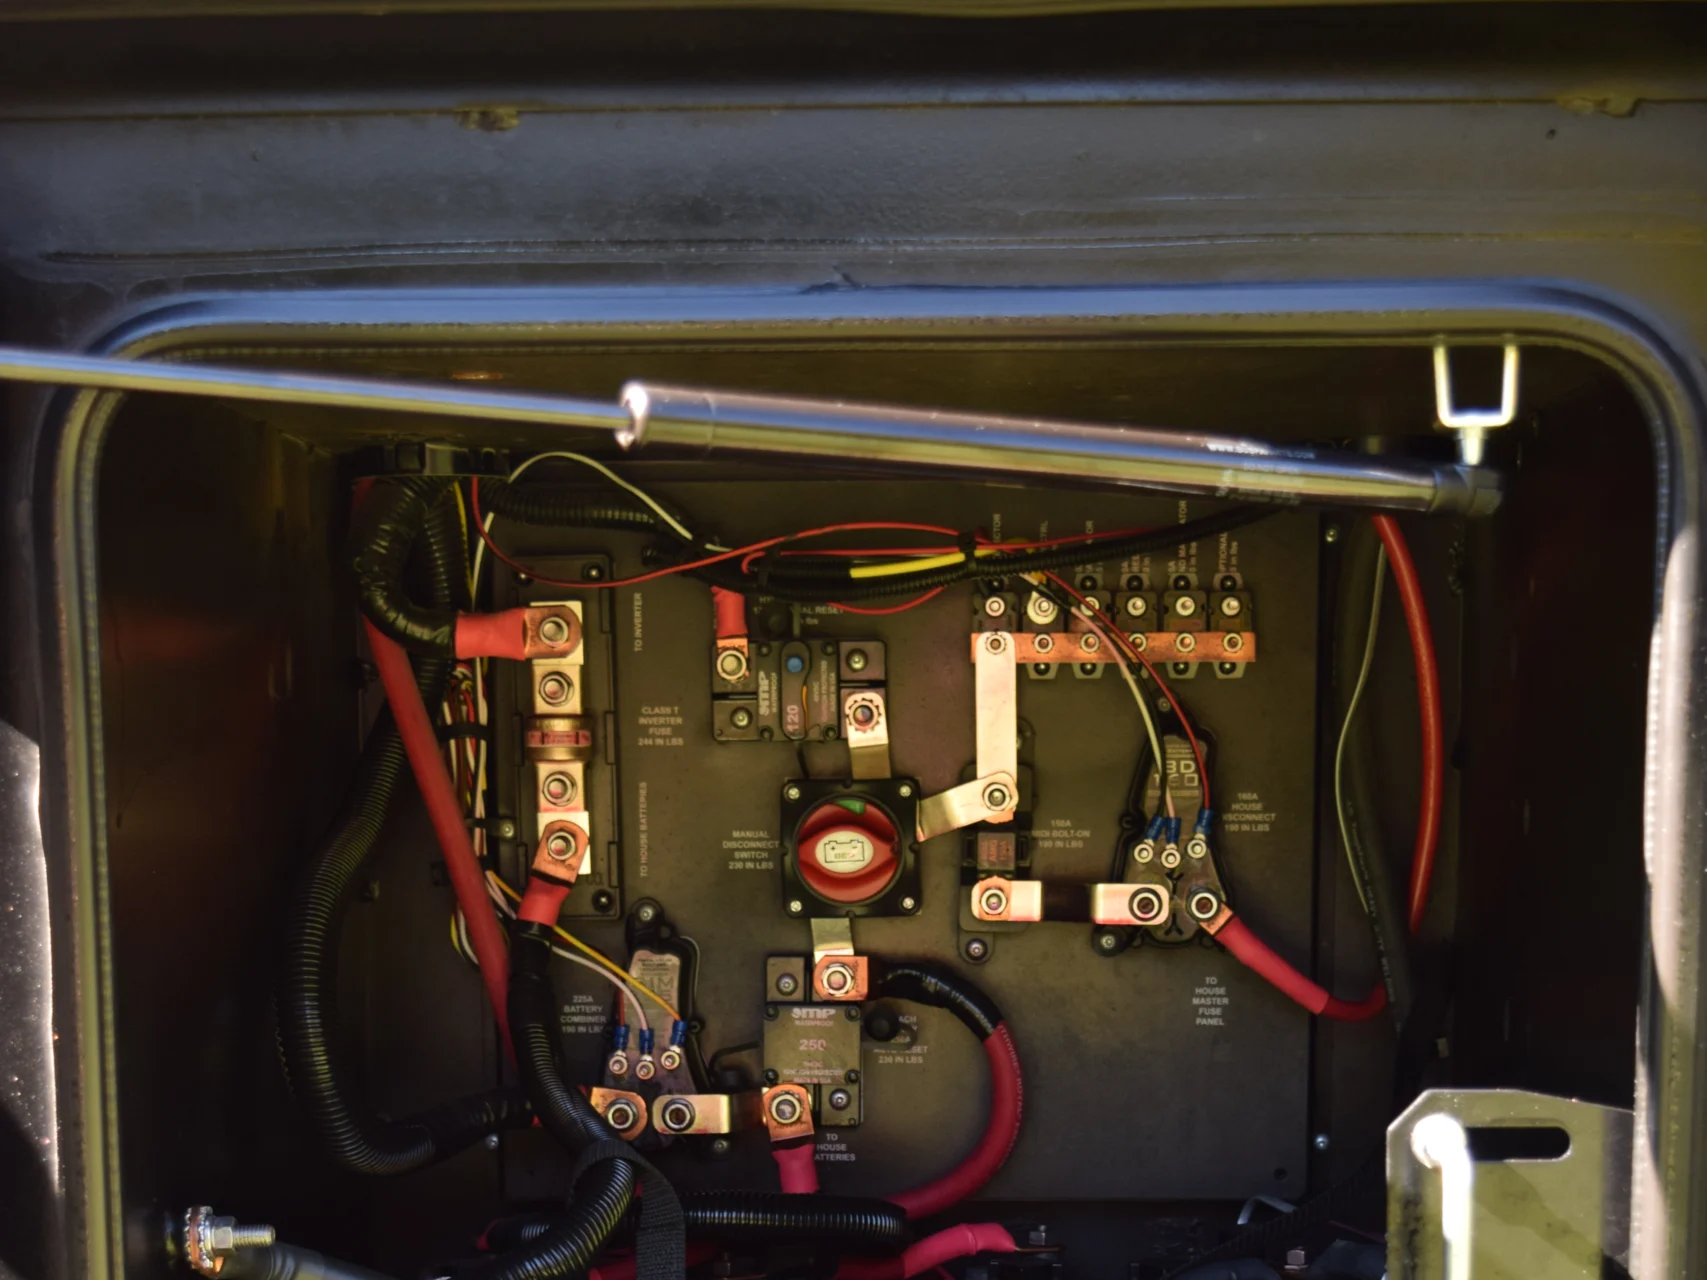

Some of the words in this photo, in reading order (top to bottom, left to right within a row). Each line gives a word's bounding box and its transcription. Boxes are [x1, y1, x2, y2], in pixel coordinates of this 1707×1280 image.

[1218, 532, 1228, 573] PTIONAL
[633, 592, 643, 638] INVERTER
[633, 639, 643, 652] TO
[641, 706, 672, 715] CLASS
[673, 706, 680, 715] T
[638, 716, 683, 726] INVERTER
[786, 704, 799, 732] 120
[648, 727, 672, 736] FUSE
[655, 737, 664, 747] IN
[666, 737, 684, 747] LBS
[638, 781, 648, 832] BATTERIES
[1231, 803, 1264, 811] HOUSE
[1222, 813, 1276, 822] ISCONNECT
[1241, 824, 1250, 832] IN
[731, 829, 770, 838] MANUAL
[639, 832, 648, 864] HOUSE
[721, 840, 780, 849] DISCONNECT
[734, 851, 769, 859] SWITCH
[745, 861, 755, 870] IN
[756, 861, 774, 870] LBS
[639, 865, 648, 878] TO
[1204, 976, 1218, 985] TO
[1194, 986, 1227, 995] HOUSE
[1192, 996, 1229, 1005] MASTER
[563, 1005, 603, 1013] BATTERY
[1198, 1007, 1223, 1016] FUSE
[560, 1015, 607, 1024] COMBINER
[1195, 1017, 1225, 1026] PANEL
[578, 1025, 587, 1034] IN
[799, 1039, 827, 1051] 250
[895, 1055, 905, 1064] IN
[906, 1055, 924, 1064] LBS
[825, 1133, 839, 1141] TO
[816, 1143, 847, 1151] HOUSE
[814, 1153, 856, 1162] ATTERIES
